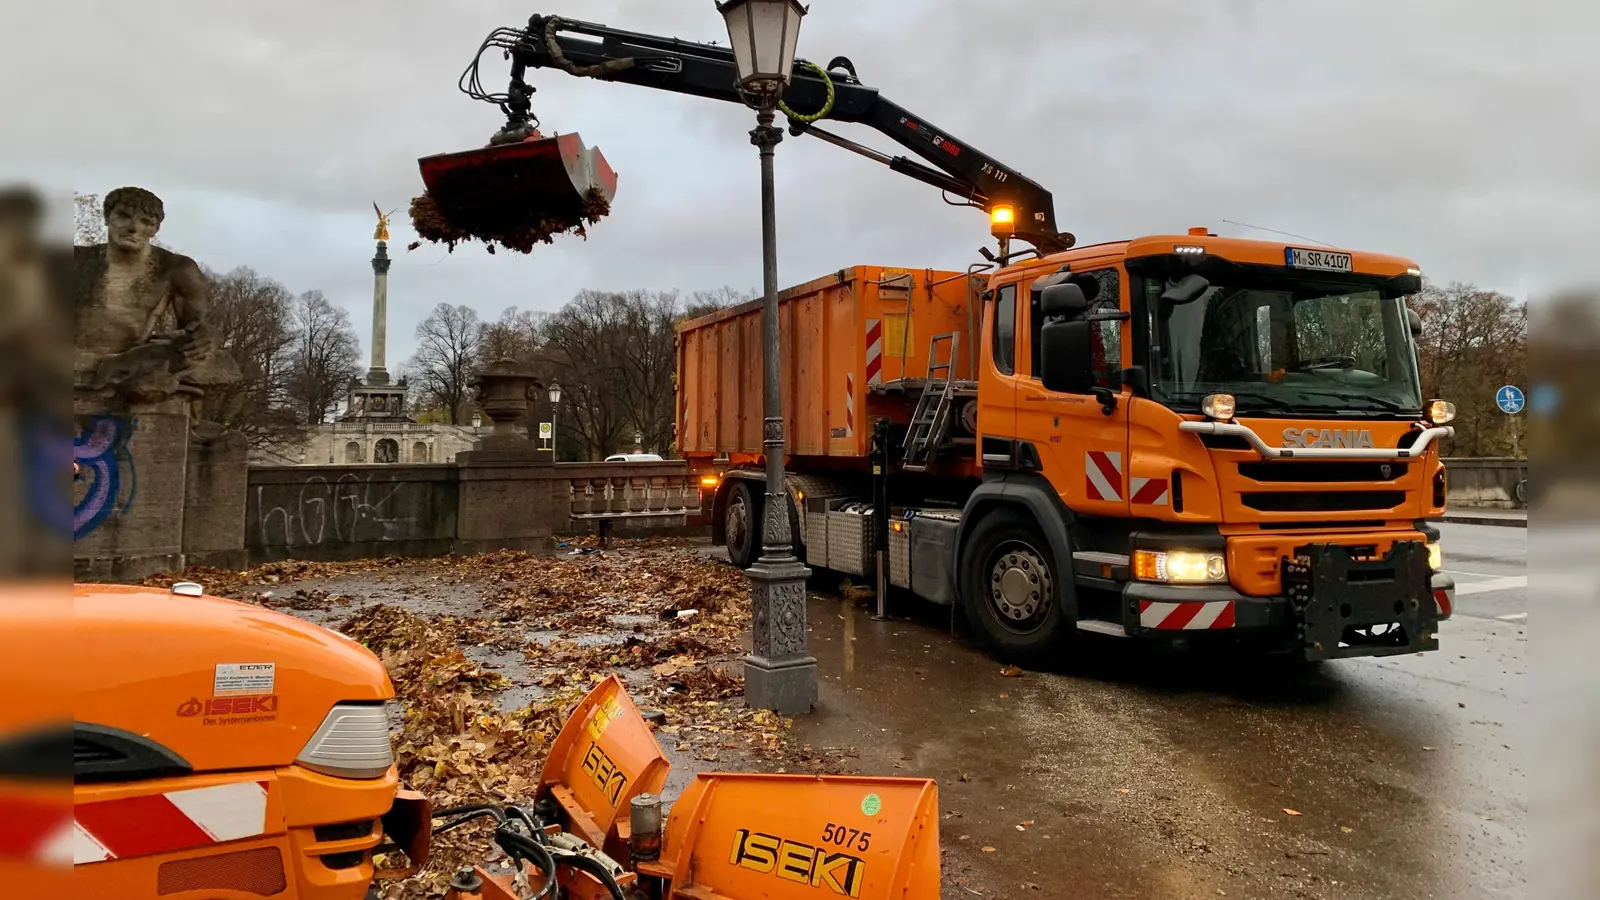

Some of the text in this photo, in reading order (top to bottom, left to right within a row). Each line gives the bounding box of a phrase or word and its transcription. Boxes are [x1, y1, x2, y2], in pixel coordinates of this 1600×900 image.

[981, 162, 1008, 182] XS 111
[1293, 250, 1349, 269] M SR 4107
[1282, 428, 1375, 449] SCANIA
[204, 696, 278, 716] ISEKI
[203, 715, 276, 726] Der Systemanbieter
[580, 741, 628, 810] ISEKI
[821, 822, 872, 852] 5075
[729, 829, 867, 899] ISEKI
